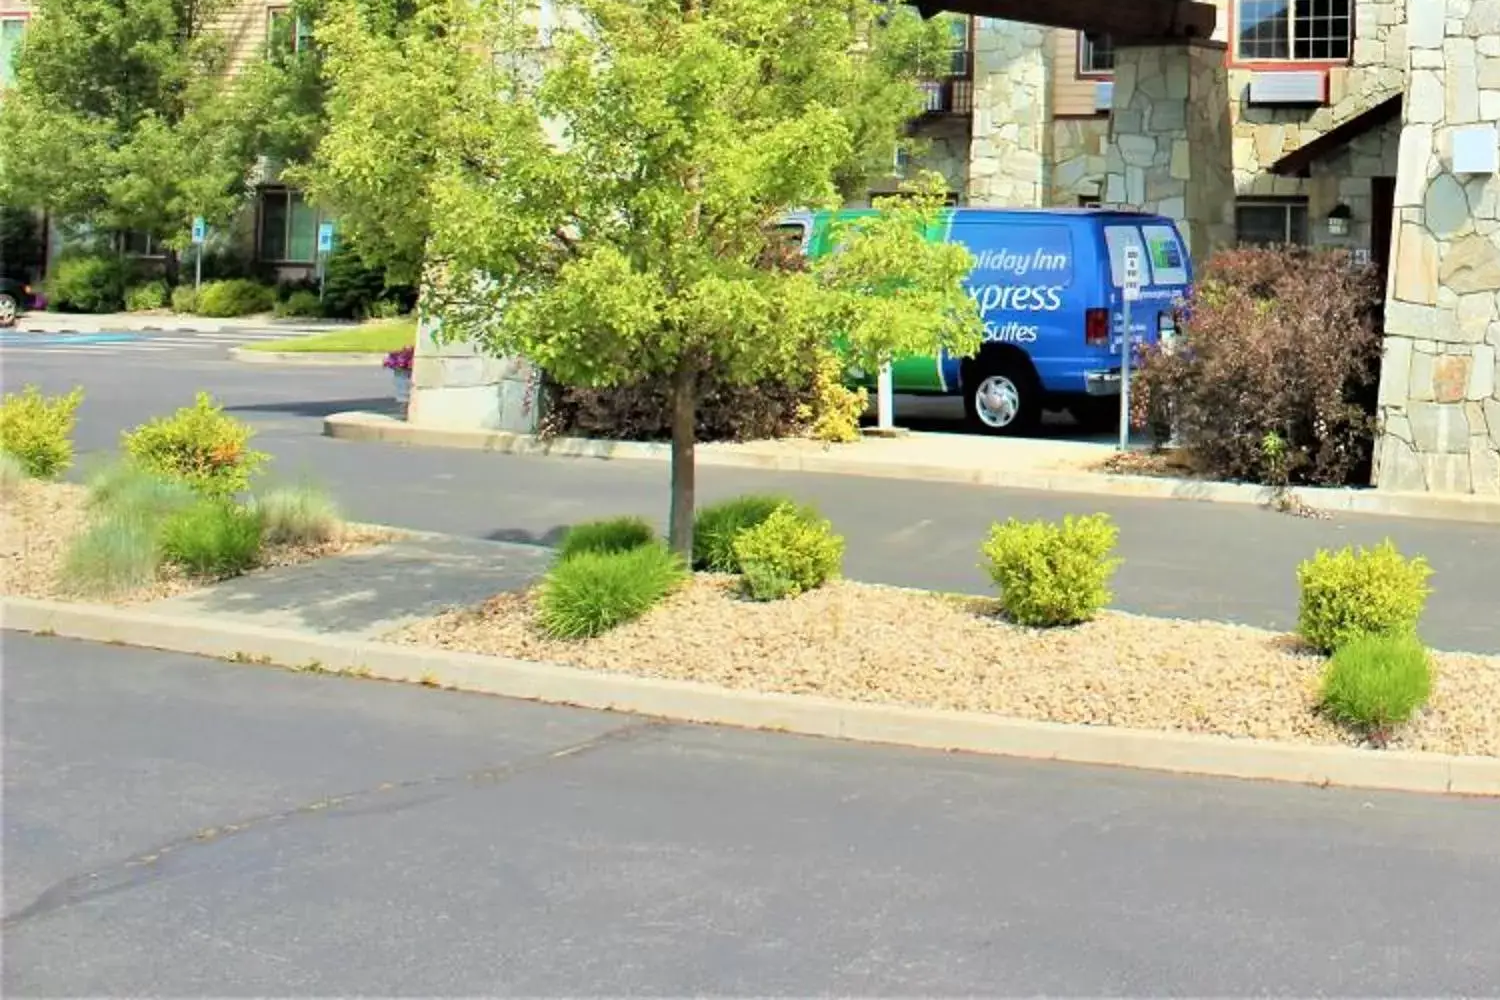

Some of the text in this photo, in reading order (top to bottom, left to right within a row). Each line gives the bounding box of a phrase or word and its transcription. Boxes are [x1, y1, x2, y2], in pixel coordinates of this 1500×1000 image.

[970, 247, 1066, 275] oliday Inn
[968, 284, 1062, 318] xpress
[982, 321, 1038, 342] Suites
